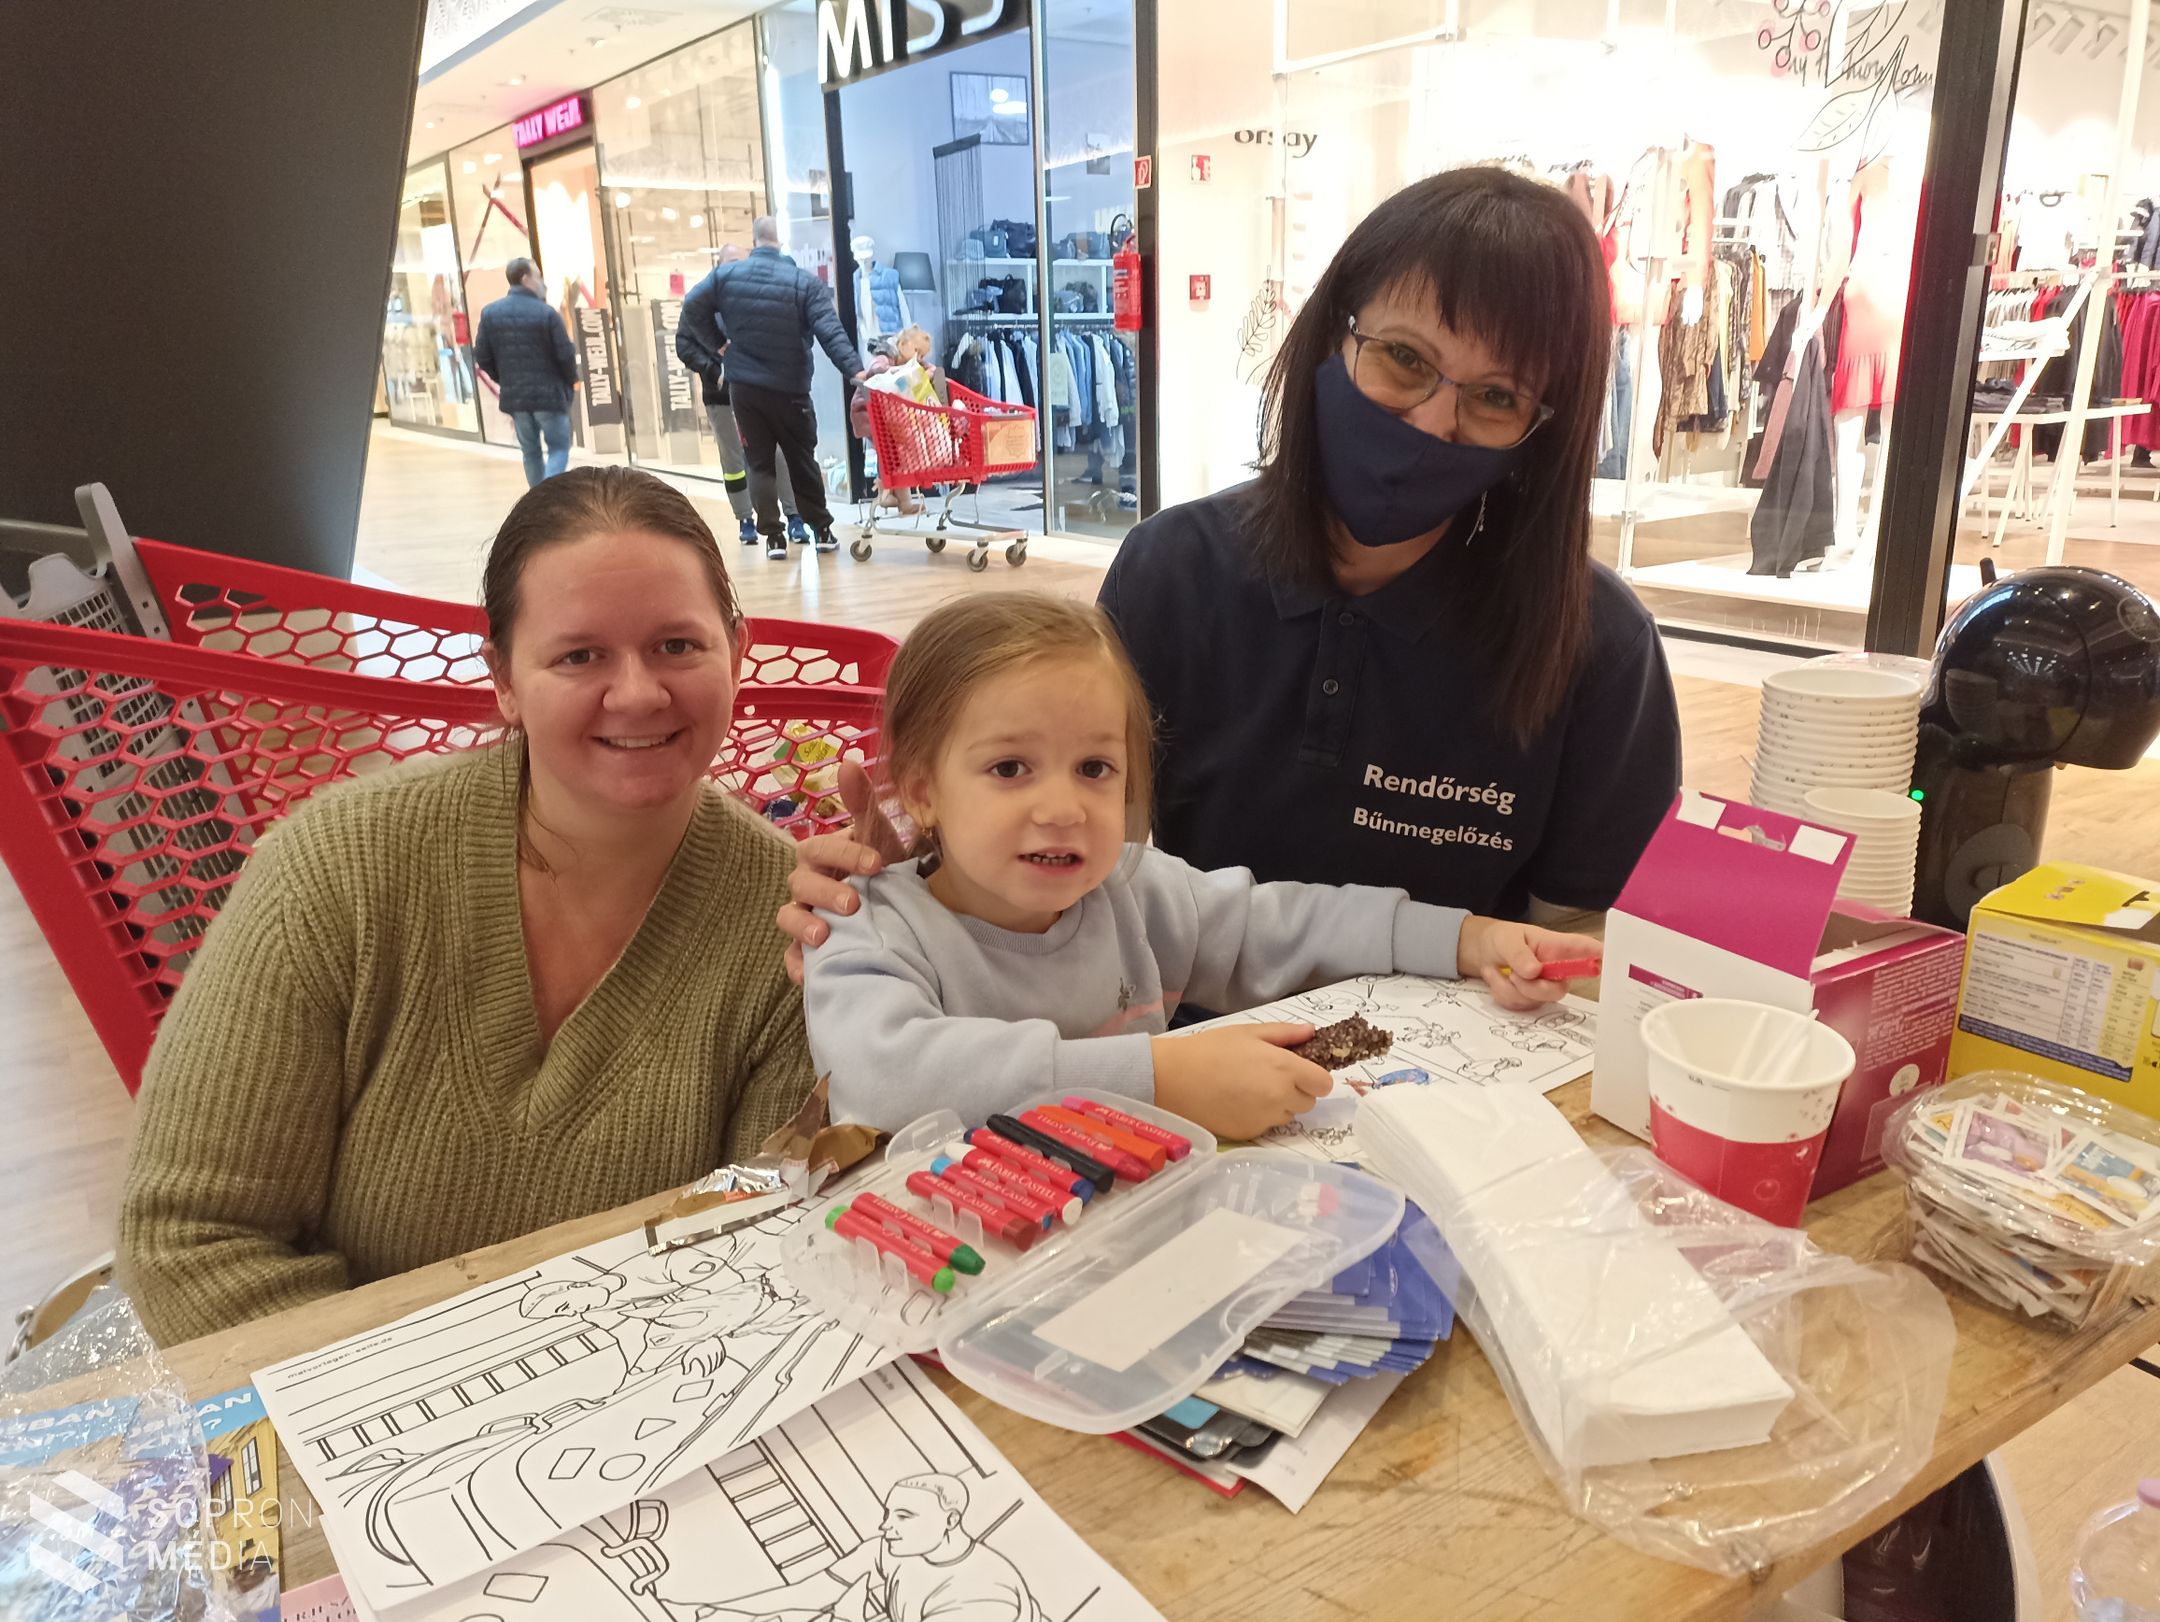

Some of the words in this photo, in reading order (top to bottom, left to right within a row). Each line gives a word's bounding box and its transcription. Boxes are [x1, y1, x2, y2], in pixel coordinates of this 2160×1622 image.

[512, 113, 543, 147] TALLY
[1363, 764, 1516, 815] Rendőrség
[1353, 807, 1514, 851] Bűnmegelőzés
